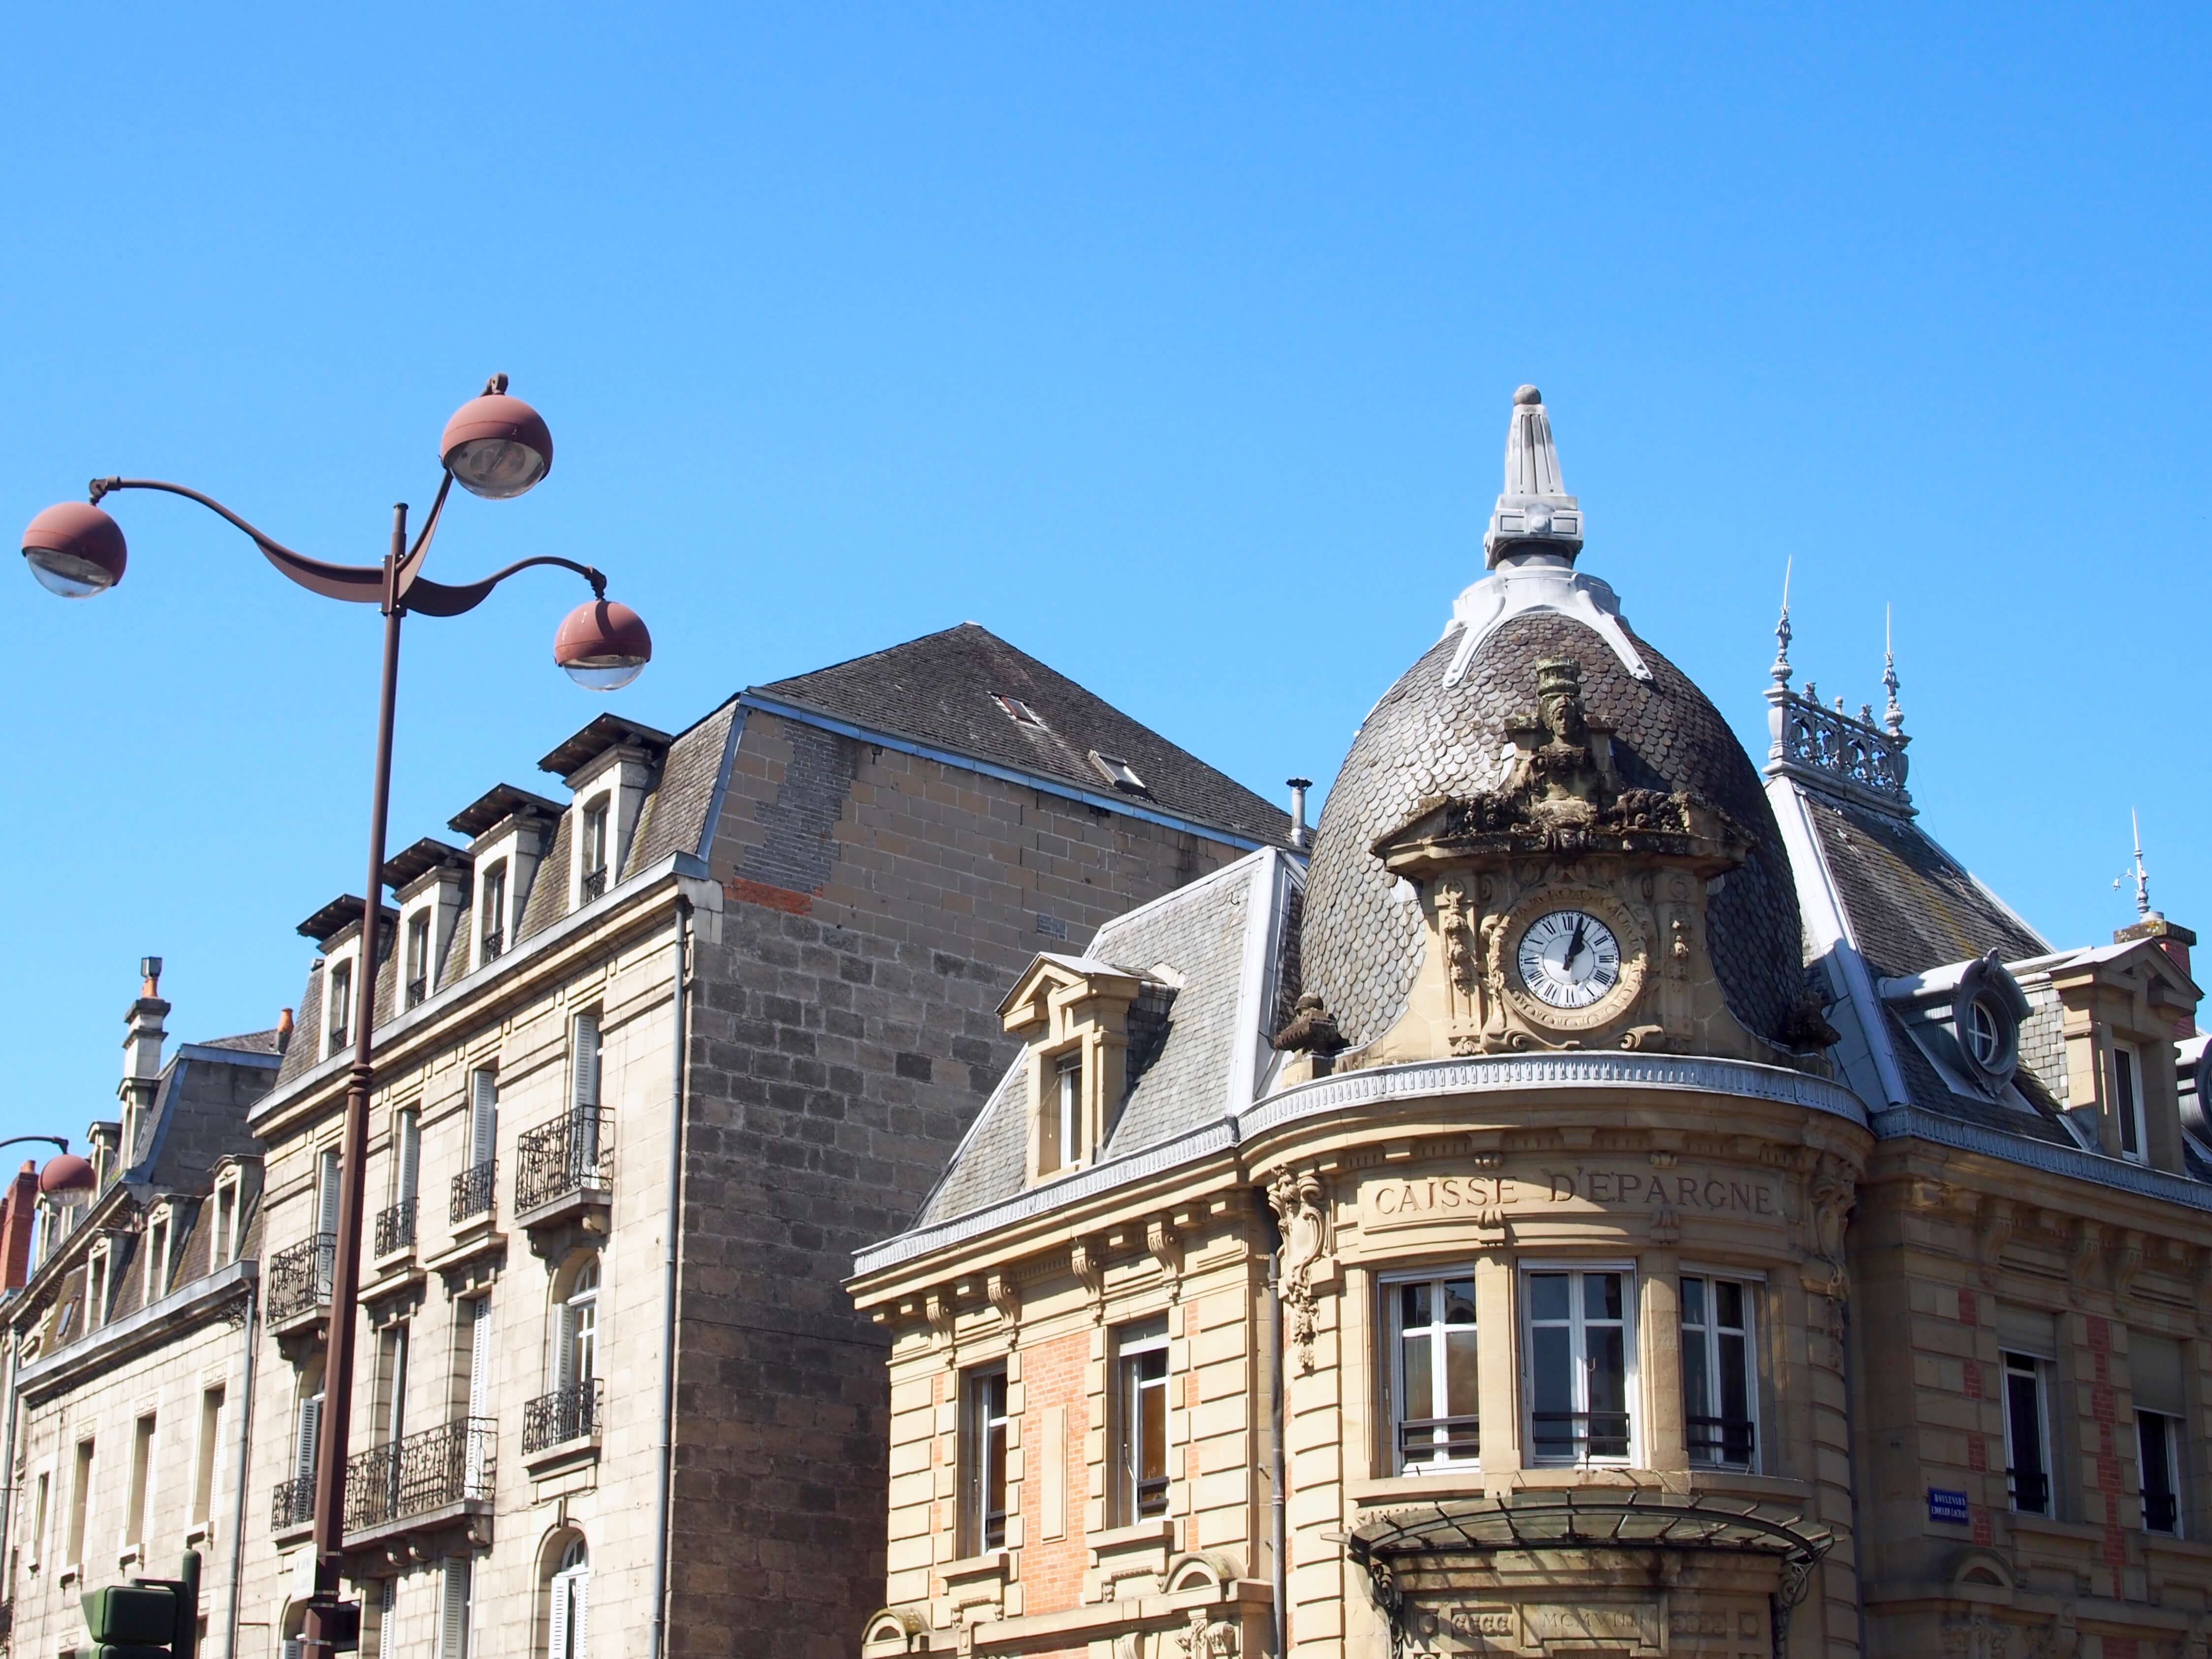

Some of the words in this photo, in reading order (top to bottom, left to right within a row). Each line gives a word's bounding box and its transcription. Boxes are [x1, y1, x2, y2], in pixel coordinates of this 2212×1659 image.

[1599, 955, 1614, 963] III
[1375, 1177, 1519, 1214] CAISSE
[1934, 1494, 1965, 1506] BOULEVARD
